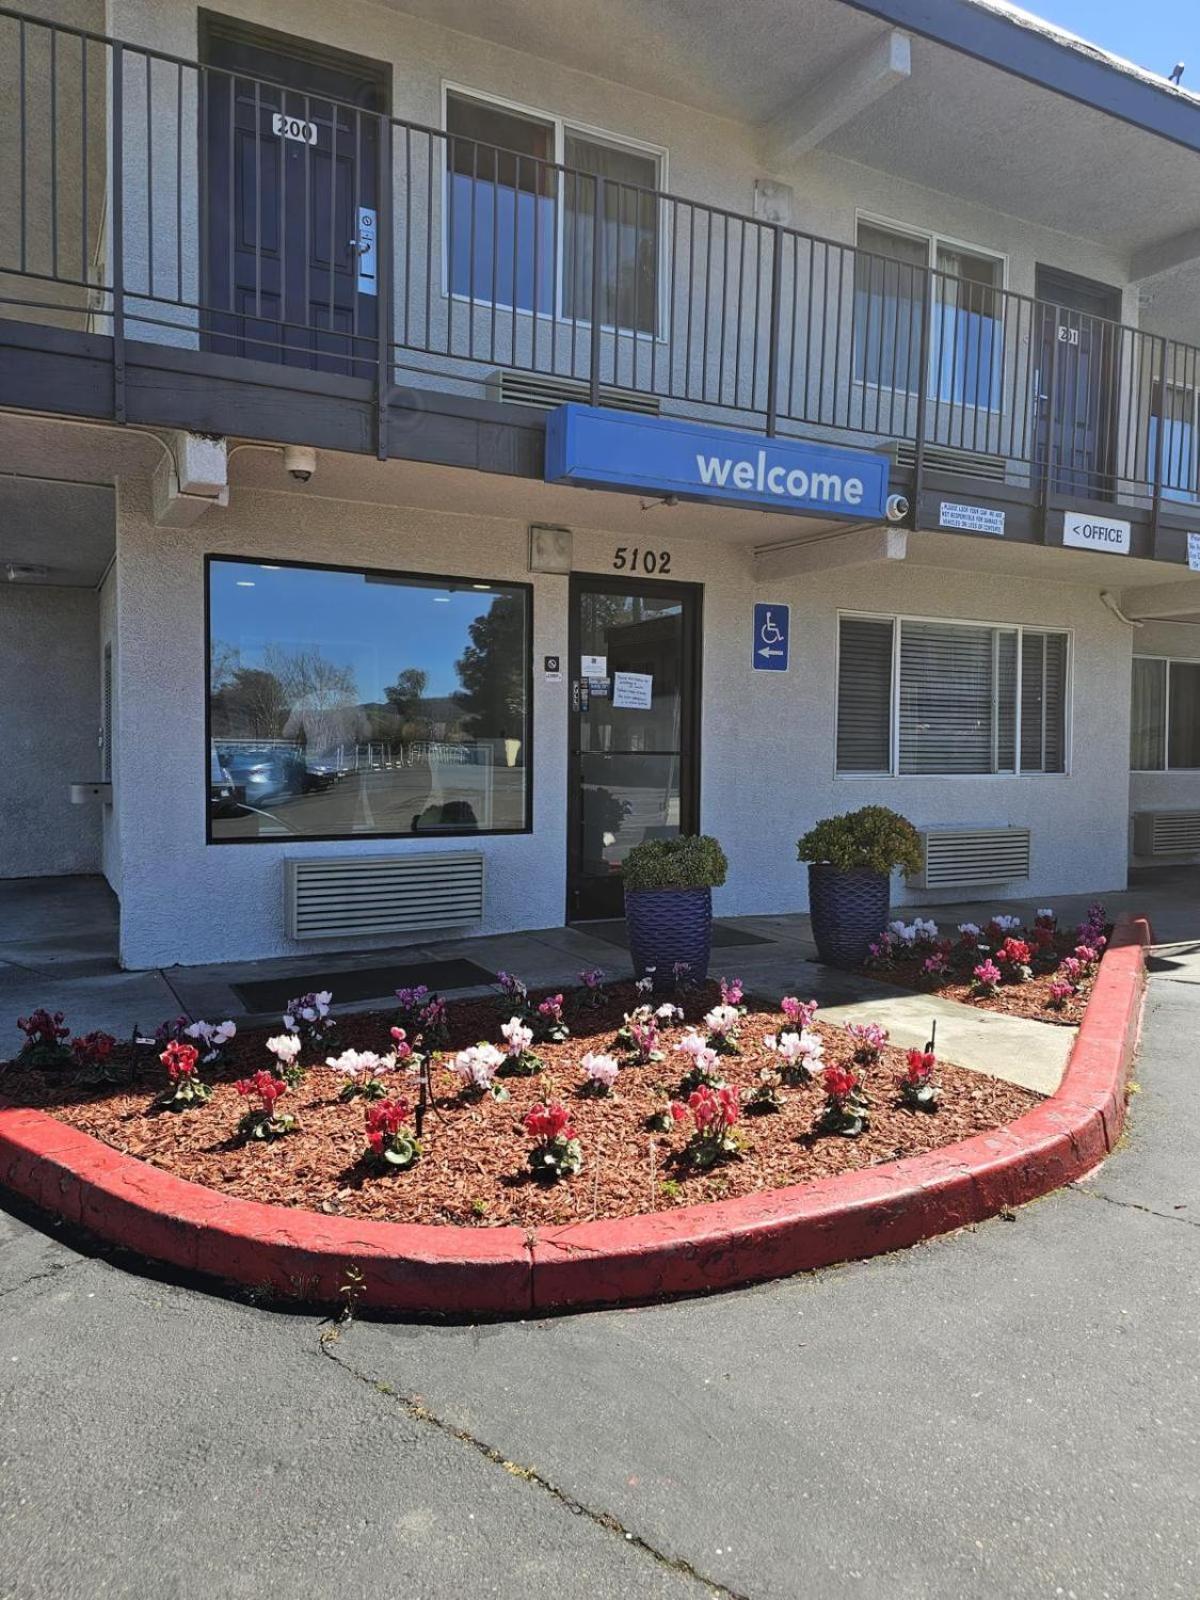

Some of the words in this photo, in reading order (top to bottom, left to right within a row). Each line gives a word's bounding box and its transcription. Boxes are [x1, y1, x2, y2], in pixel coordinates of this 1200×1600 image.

[278, 117, 312, 141] 200
[696, 450, 864, 505] welcome
[1083, 524, 1122, 543] OFFICE
[613, 547, 671, 574] 5102
